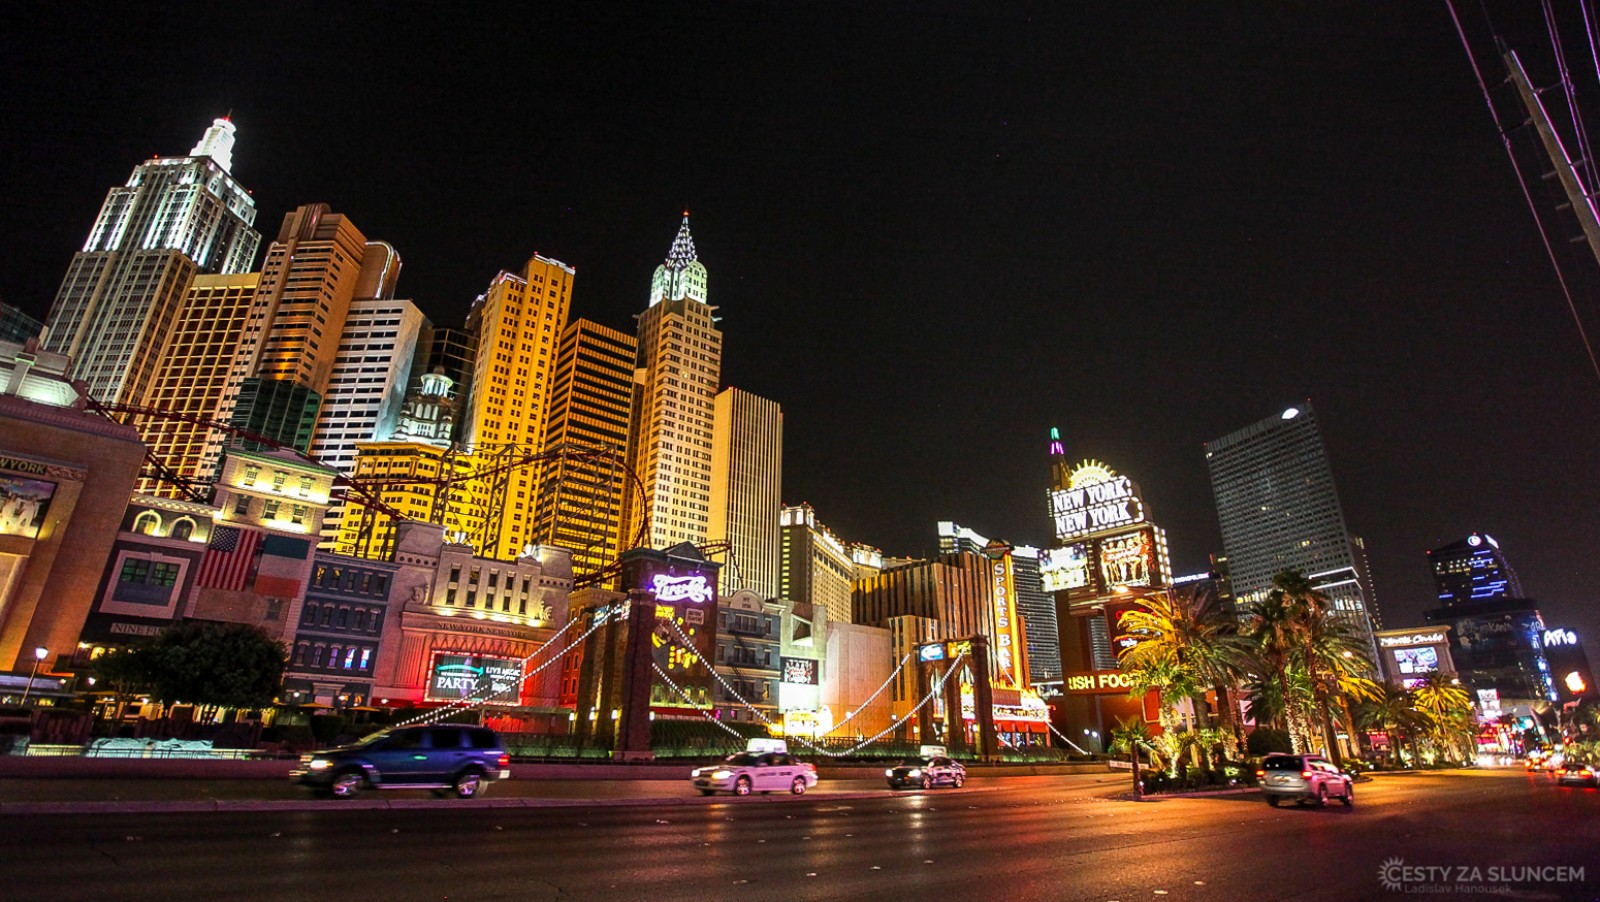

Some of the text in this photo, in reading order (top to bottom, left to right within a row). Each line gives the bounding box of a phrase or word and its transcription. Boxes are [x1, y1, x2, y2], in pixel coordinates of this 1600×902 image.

[1052, 479, 1129, 513] NEW YORK
[1055, 501, 1132, 535] NEW YORK
[993, 563, 1009, 628] SPORTS
[114, 623, 143, 635] NINE
[436, 621, 458, 631] NEW
[460, 623, 486, 634] YORK
[998, 634, 1012, 669] BAR
[436, 676, 480, 691] PARTY
